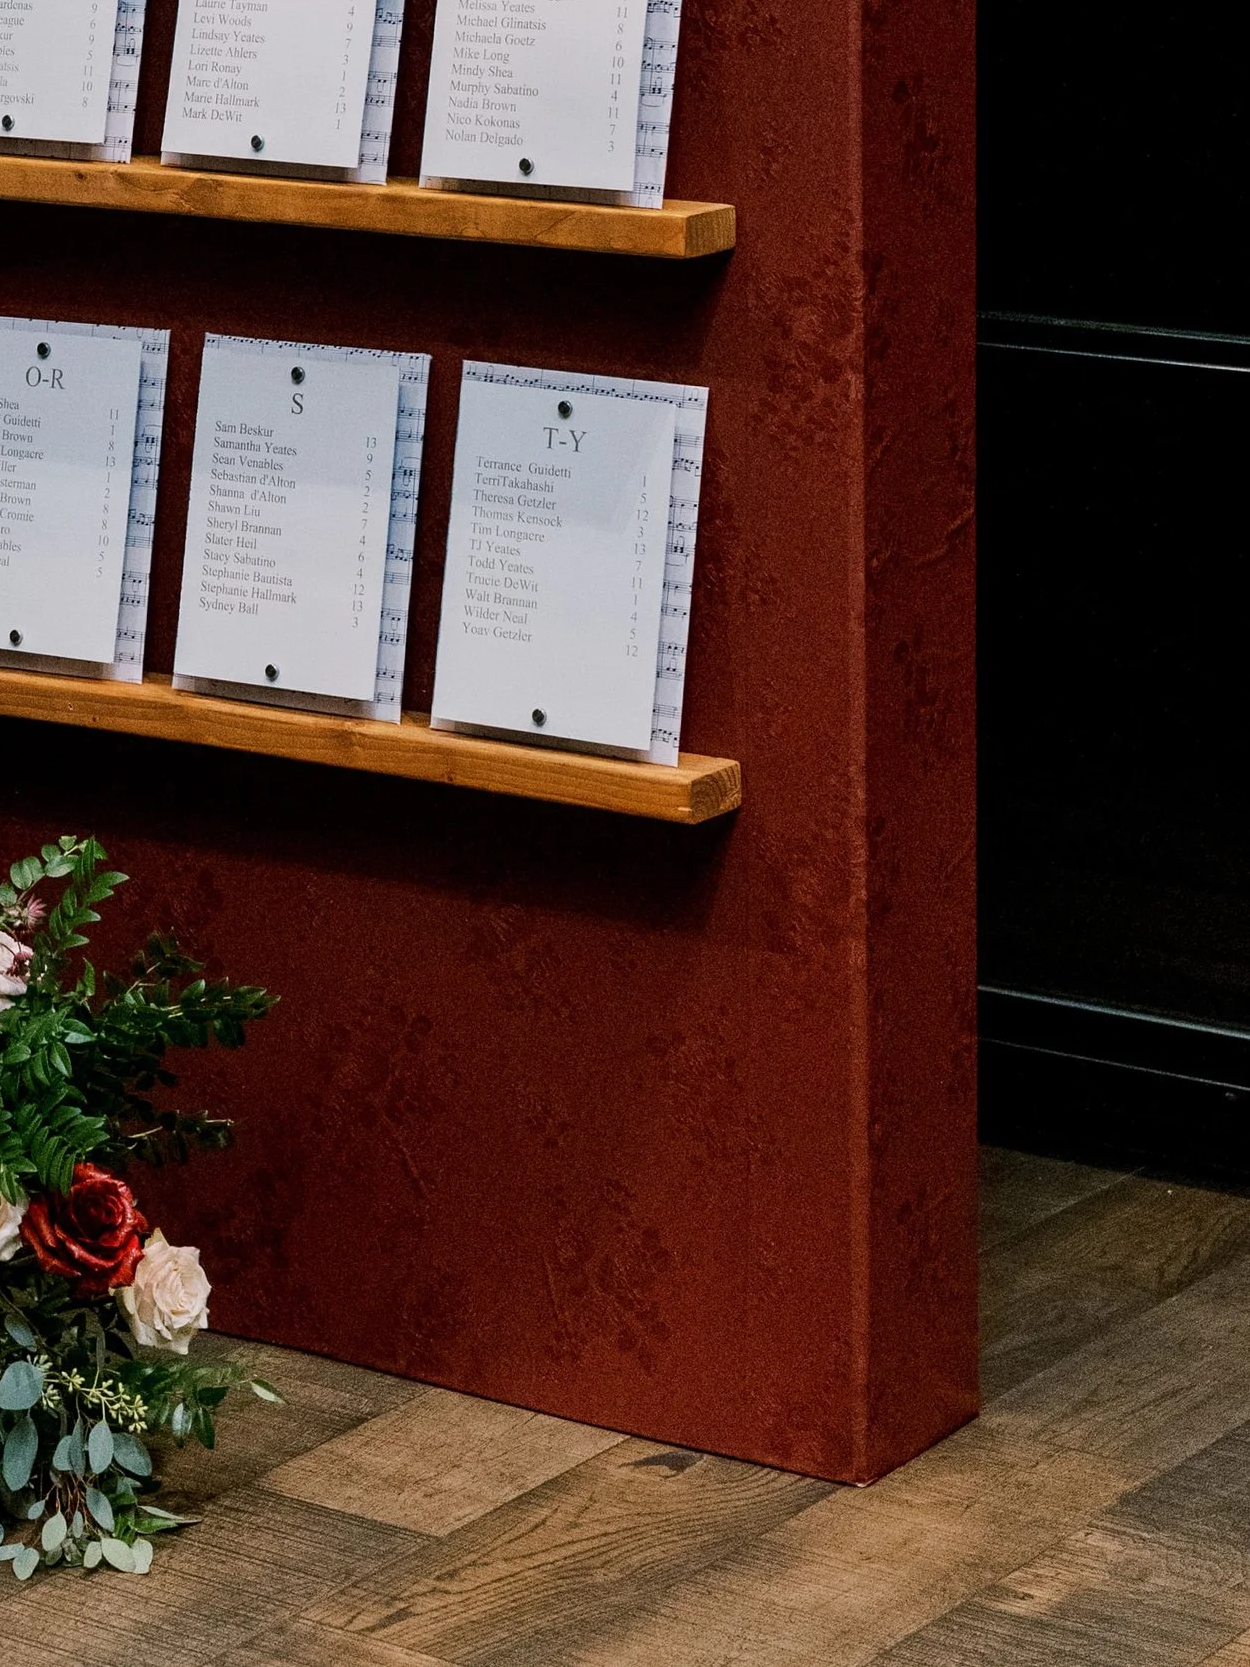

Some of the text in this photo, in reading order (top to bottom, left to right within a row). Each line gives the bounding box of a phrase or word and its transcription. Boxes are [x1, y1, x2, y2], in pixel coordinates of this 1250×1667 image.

[90, 19, 96, 29] 6
[194, 13, 353, 32] Levi Woods 9
[453, 47, 624, 68] Mike Long 10
[82, 82, 92, 91] 10
[450, 80, 617, 101] Murphy Sabatino 4
[182, 107, 207, 120] Mark
[211, 109, 243, 122] DeWit
[449, 97, 618, 118] Nadia Brown 11
[446, 129, 614, 151] Nolan Delgado 3
[26, 366, 65, 390] O-R
[110, 409, 118, 420] 11
[291, 393, 304, 415] S
[3, 414, 42, 428] Guidetti
[2, 429, 33, 443] Brown
[109, 441, 114, 450] 8
[215, 421, 376, 448] Sam Beskur 13
[543, 427, 587, 453] T-Y
[1, 445, 44, 460] Longacre
[106, 456, 116, 467] 13
[214, 437, 373, 463] Samantha Yeates 9
[477, 456, 522, 473] Terrance
[528, 463, 572, 479] Guidetti
[211, 469, 257, 485] Sebastian
[364, 486, 370, 497] 2
[640, 493, 646, 503] 5
[208, 501, 367, 529] Shawn Liu 7
[98, 535, 109, 546] 10
[205, 533, 364, 562] Slater Heil 6
[470, 539, 641, 571] TJ Yeates 7
[96, 567, 102, 578] 5
[469, 556, 642, 589] Todd Yeates 11
[199, 598, 358, 628] Sydney Ball 3
[465, 589, 637, 622] Walt Brannan 4
[464, 605, 636, 639] Wilder Neal 5
